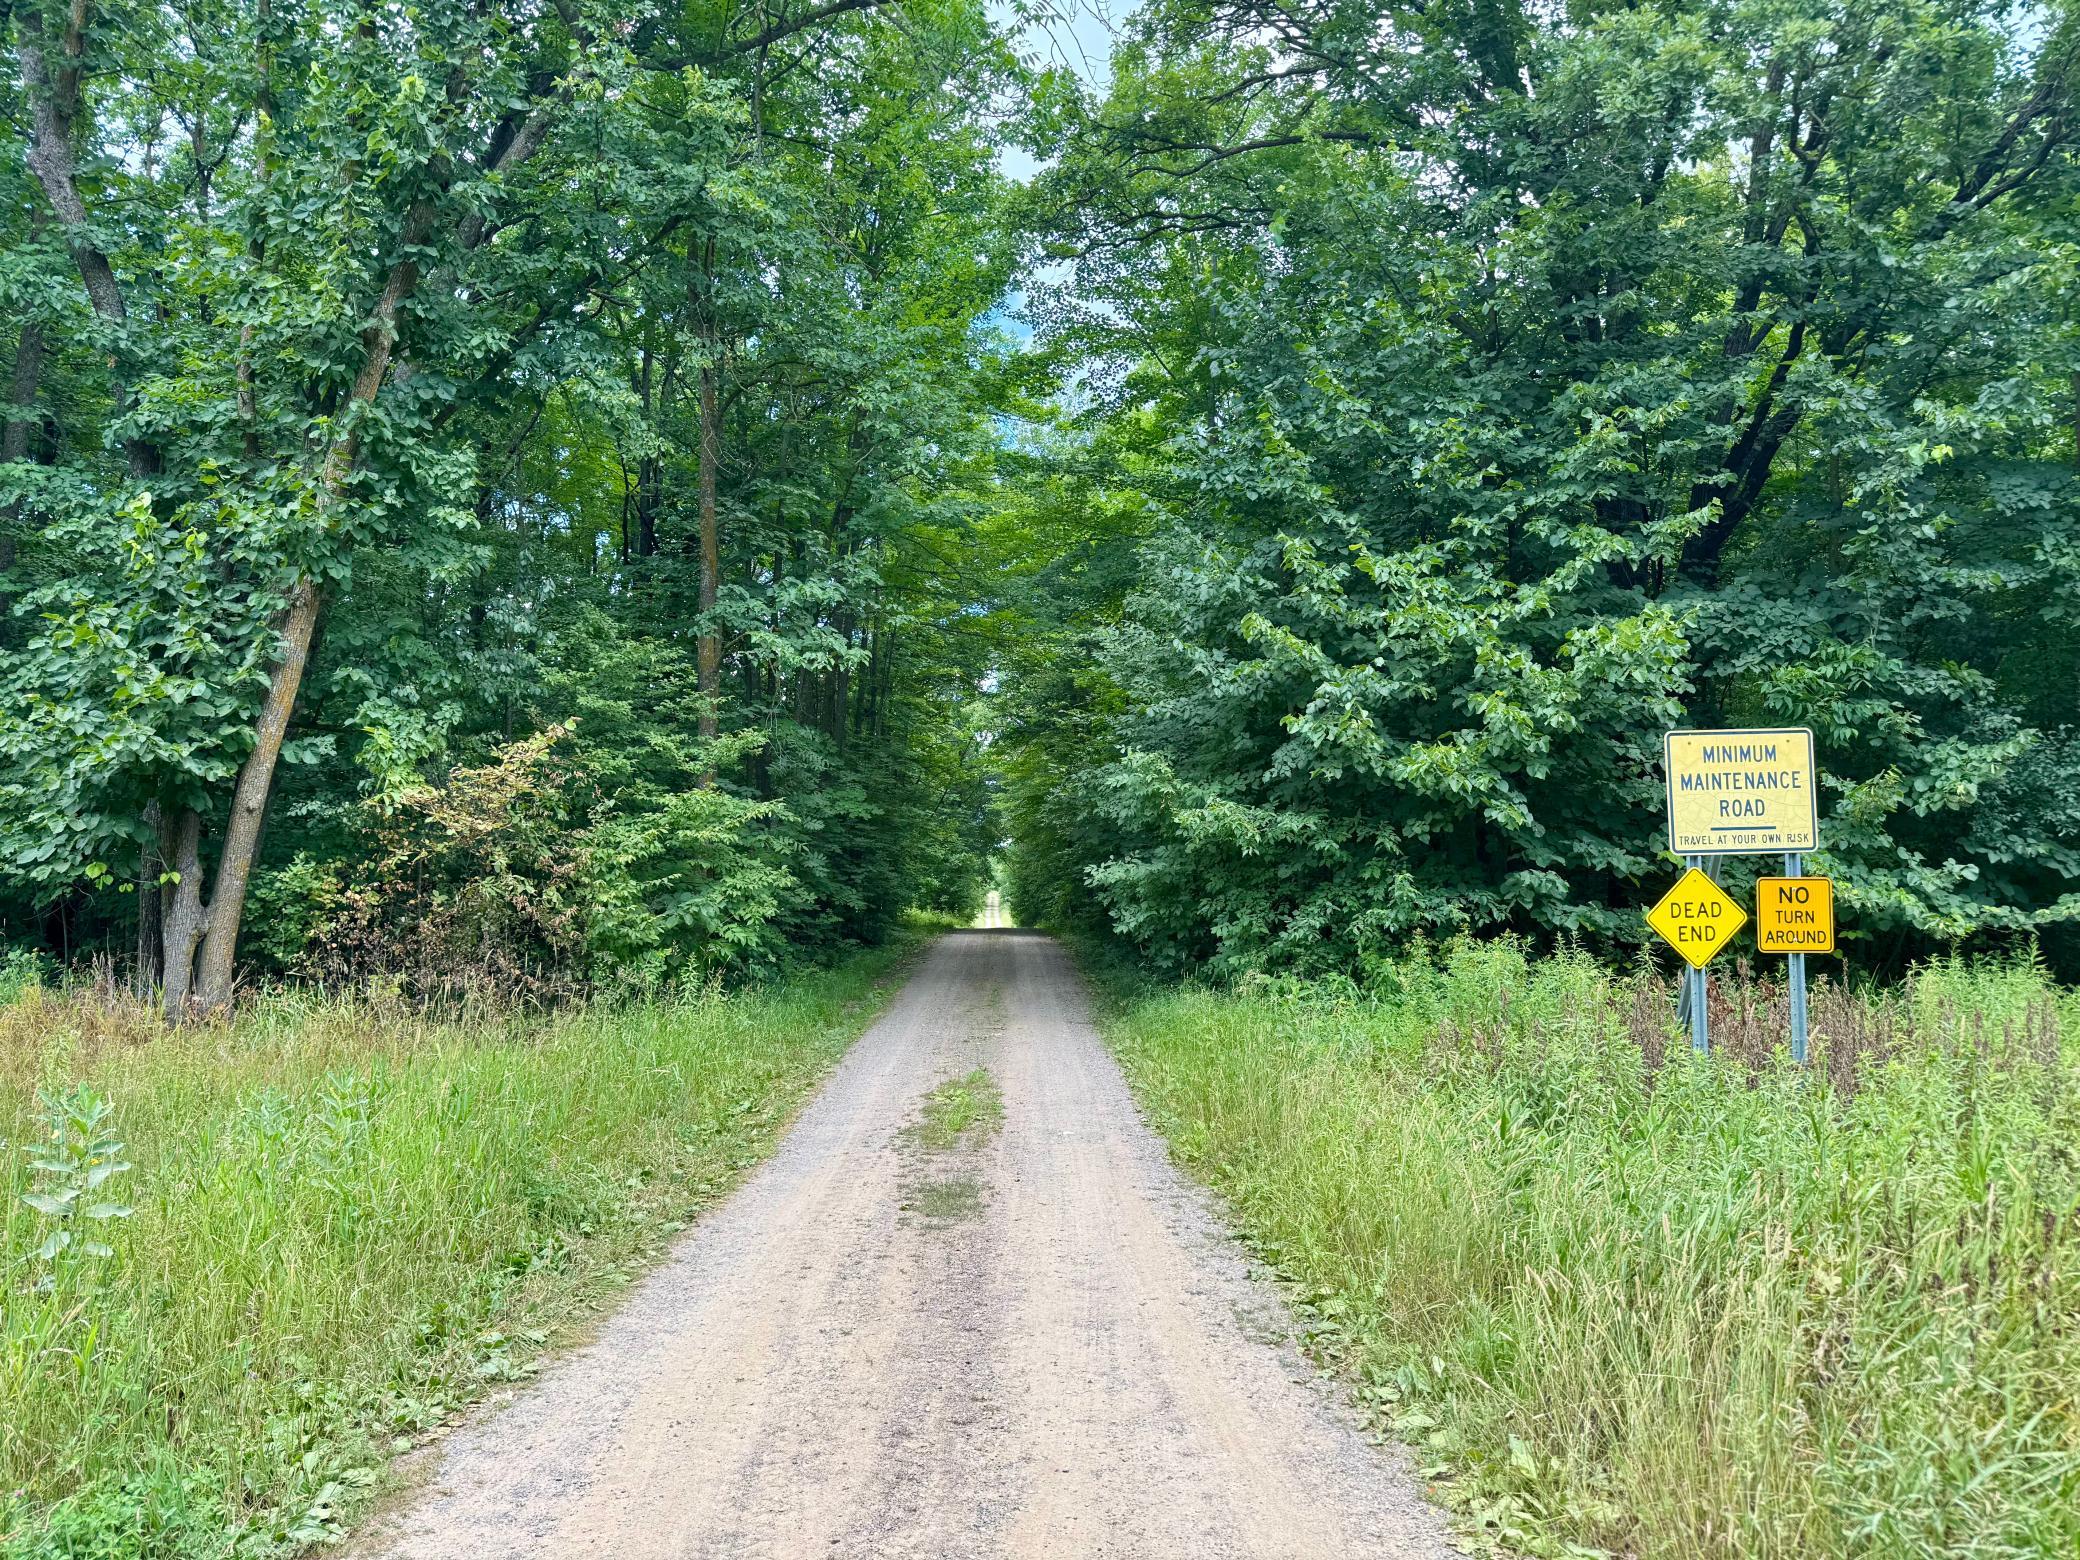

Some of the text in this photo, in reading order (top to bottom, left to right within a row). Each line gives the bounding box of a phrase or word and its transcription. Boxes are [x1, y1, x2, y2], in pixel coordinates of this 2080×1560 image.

[1702, 744, 1777, 763] MINIMUM
[1680, 771, 1801, 791] MAINTENANCE
[1719, 799, 1765, 817] ROAD
[1679, 833, 1809, 846] TRAVEL AT YOUR OWN RISK
[1778, 886, 1809, 904] NO
[1670, 901, 1722, 919] DEAD
[1775, 910, 1815, 924] TURN
[1678, 925, 1716, 942] END
[1765, 930, 1827, 944] AROUND
